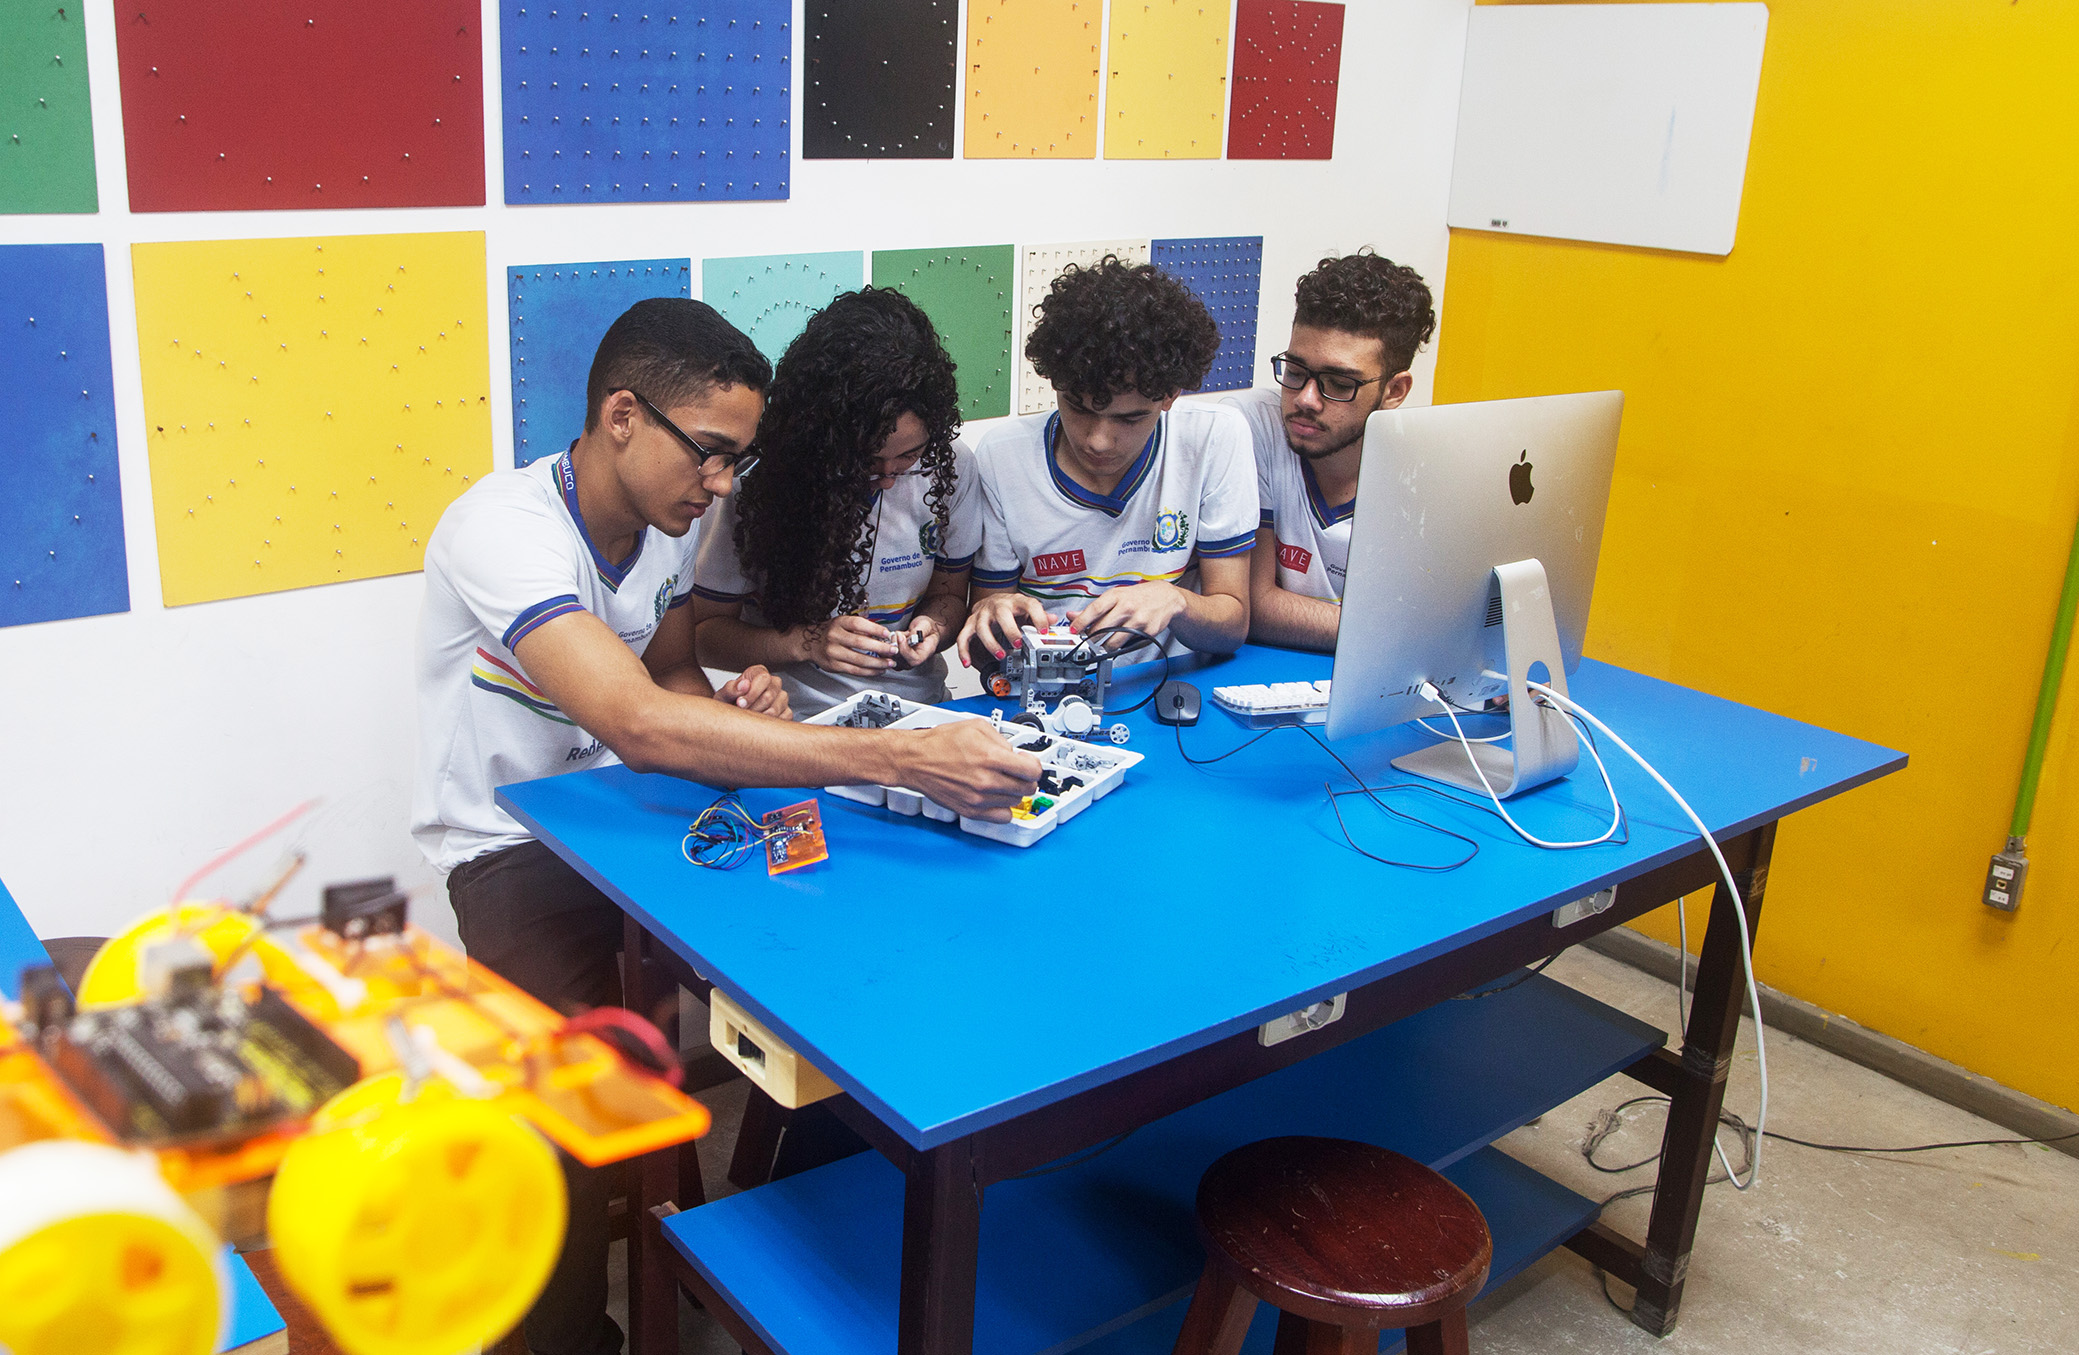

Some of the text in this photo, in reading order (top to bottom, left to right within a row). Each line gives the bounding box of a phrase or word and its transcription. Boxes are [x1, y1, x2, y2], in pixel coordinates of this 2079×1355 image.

[1121, 540, 1150, 548] Governo
[881, 554, 911, 565] Governo
[1038, 553, 1081, 570] NAVE
[1280, 547, 1308, 566] AVE
[880, 560, 923, 573] Pernambuco
